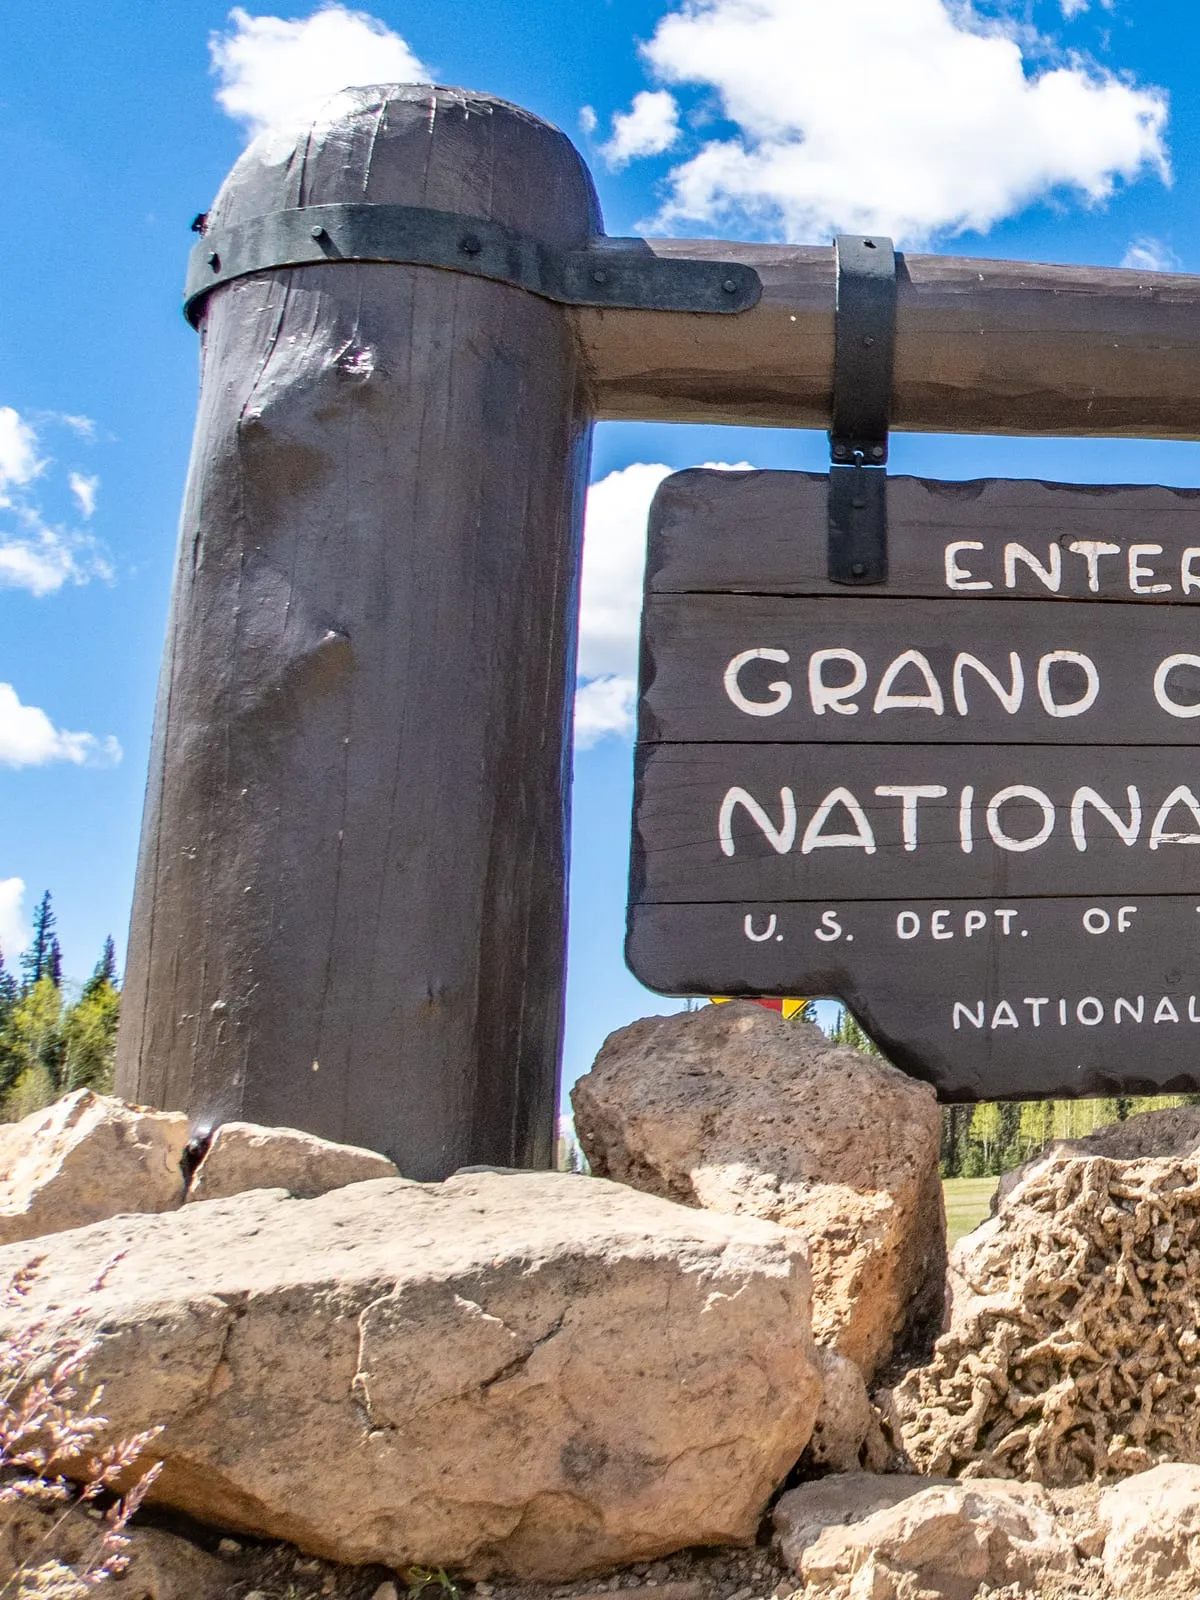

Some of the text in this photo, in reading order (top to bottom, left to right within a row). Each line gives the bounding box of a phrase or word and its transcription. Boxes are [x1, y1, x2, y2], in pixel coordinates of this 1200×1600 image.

[723, 647, 1100, 718] GRAND
[744, 914, 784, 942] U.
[814, 910, 854, 942] S.
[896, 909, 1029, 940] DEPT.
[1082, 905, 1138, 935] OF
